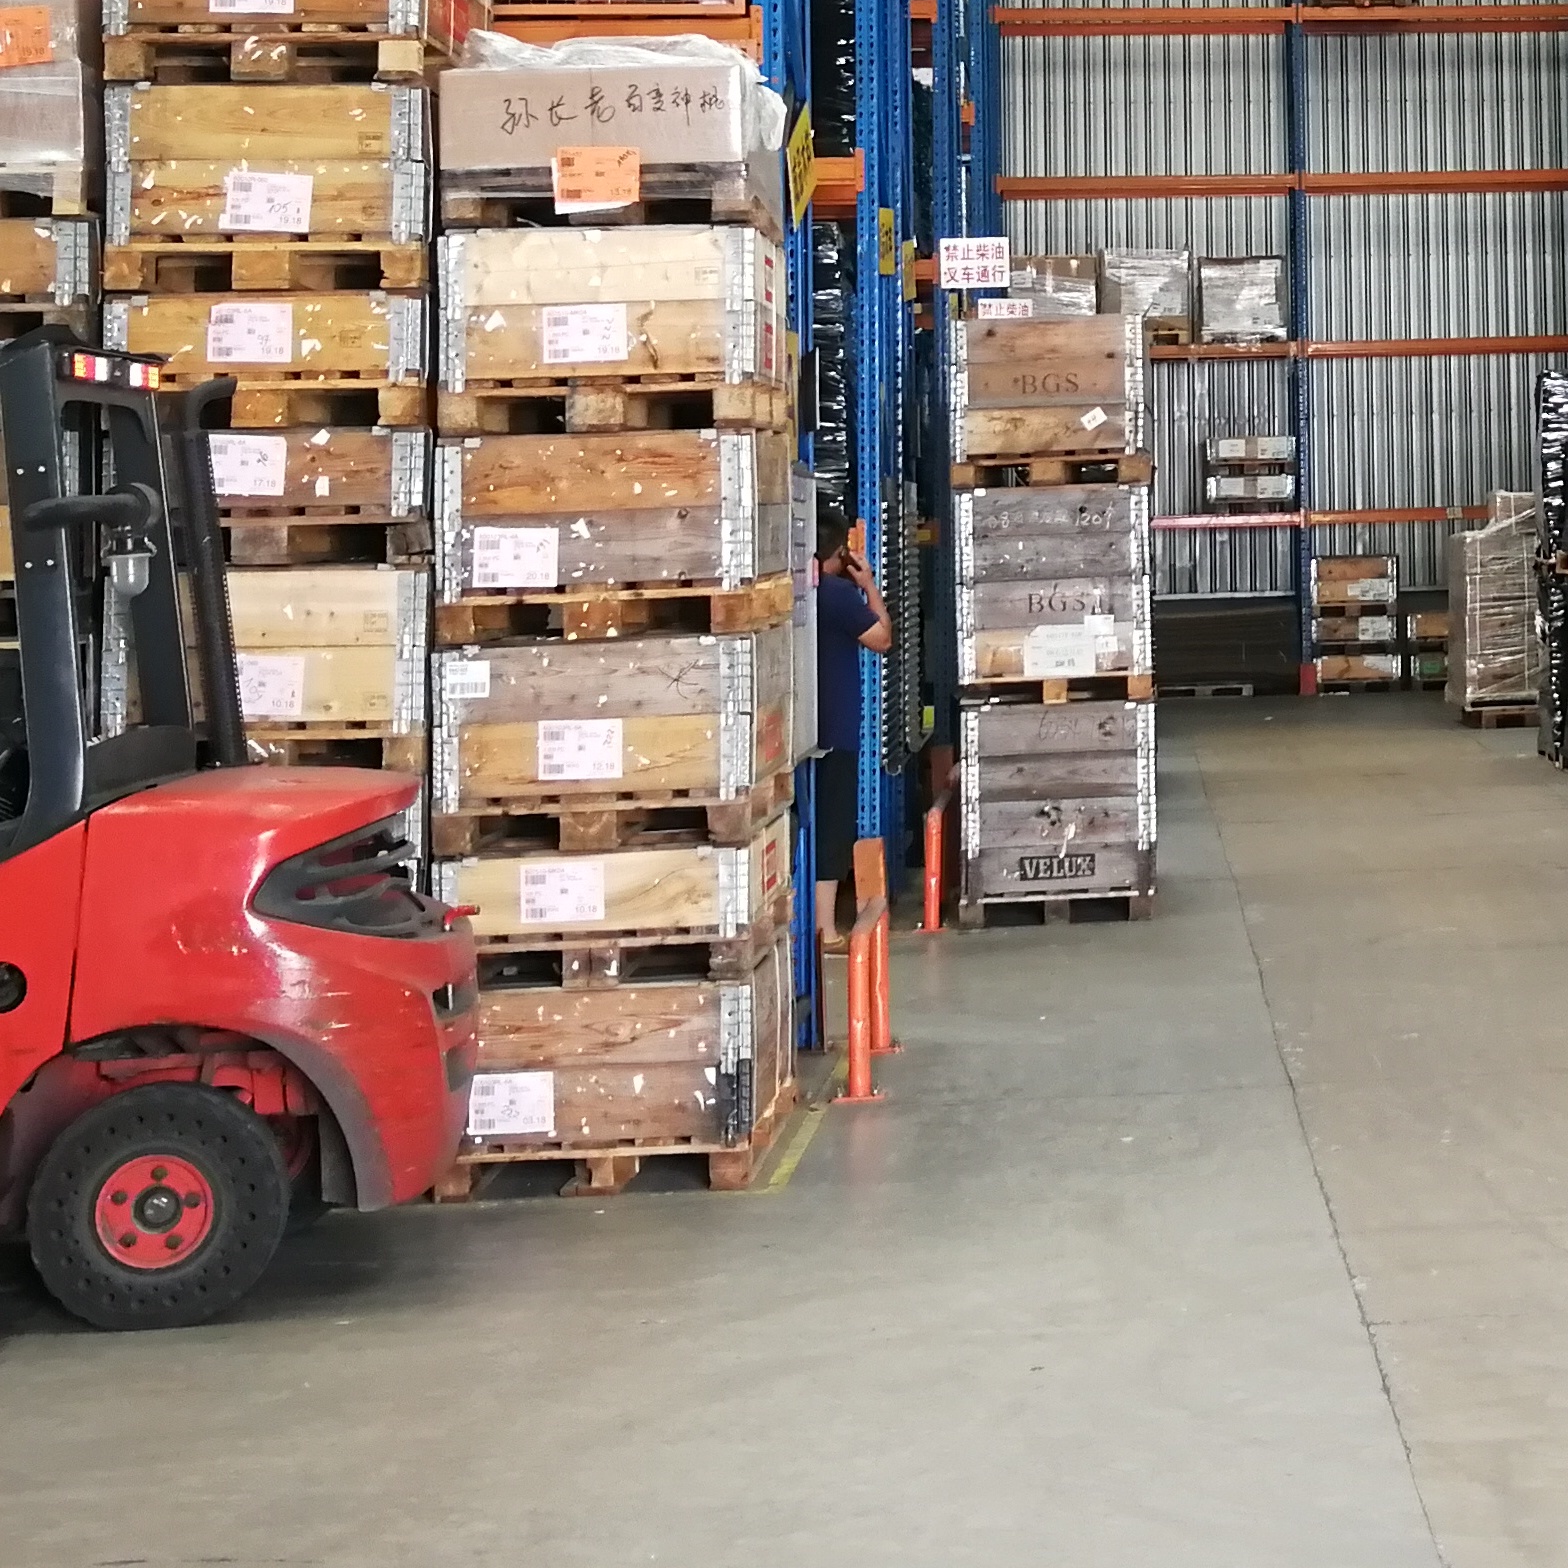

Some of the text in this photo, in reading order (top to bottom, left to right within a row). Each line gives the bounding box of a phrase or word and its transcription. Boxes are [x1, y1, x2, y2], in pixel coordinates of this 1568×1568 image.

[944, 243, 1005, 262] 禁止柴油
[945, 264, 1006, 284] 叉车通行
[979, 301, 1030, 317] 禁止柴油
[1020, 372, 1080, 395] BGS
[1028, 588, 1087, 614] BGS
[1023, 855, 1093, 879] VELUX
